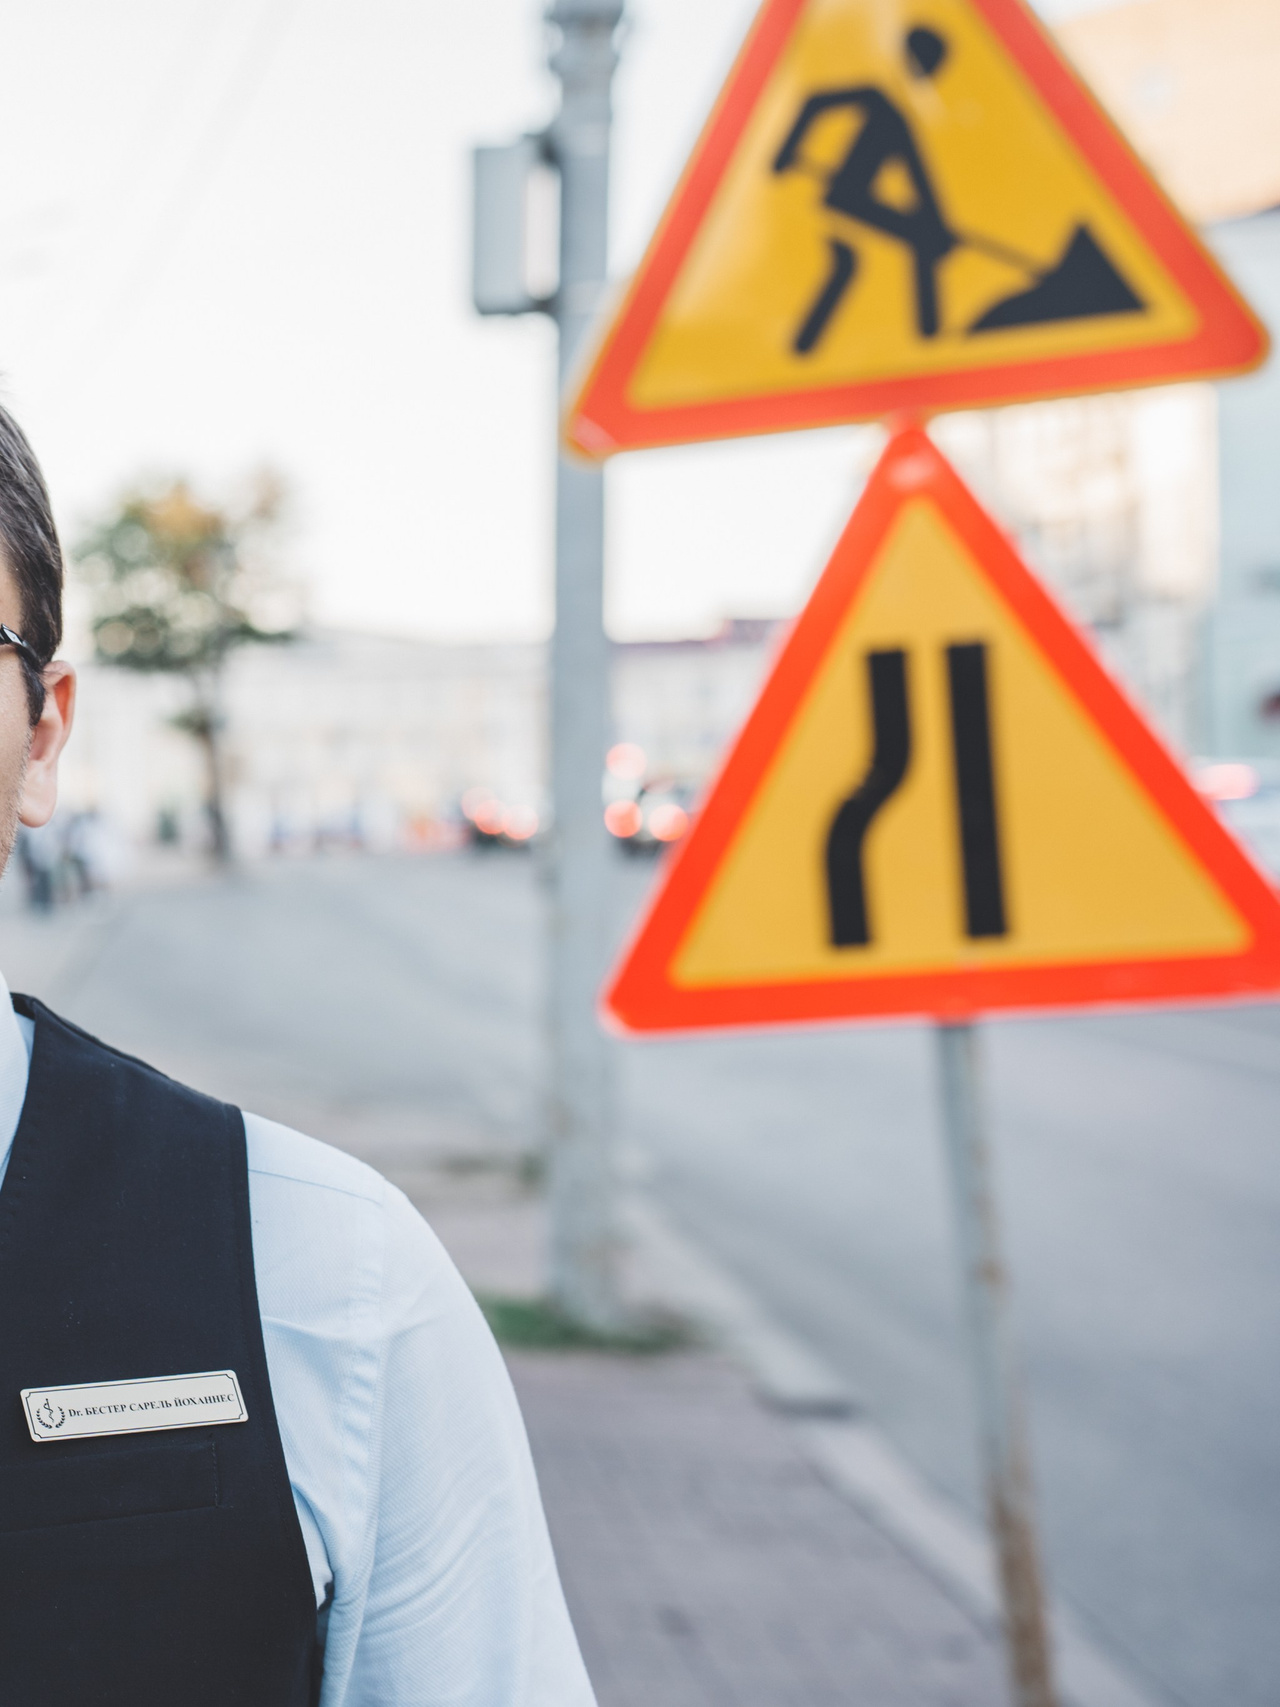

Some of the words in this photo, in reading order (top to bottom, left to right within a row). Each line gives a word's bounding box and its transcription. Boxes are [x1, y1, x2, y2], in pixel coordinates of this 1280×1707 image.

[68, 1408, 83, 1417] Dr.
[85, 1404, 127, 1416] БЕСТЕР
[129, 1400, 172, 1412] САРЕЛЬ
[174, 1394, 234, 1407] ЙОХАННЕС
